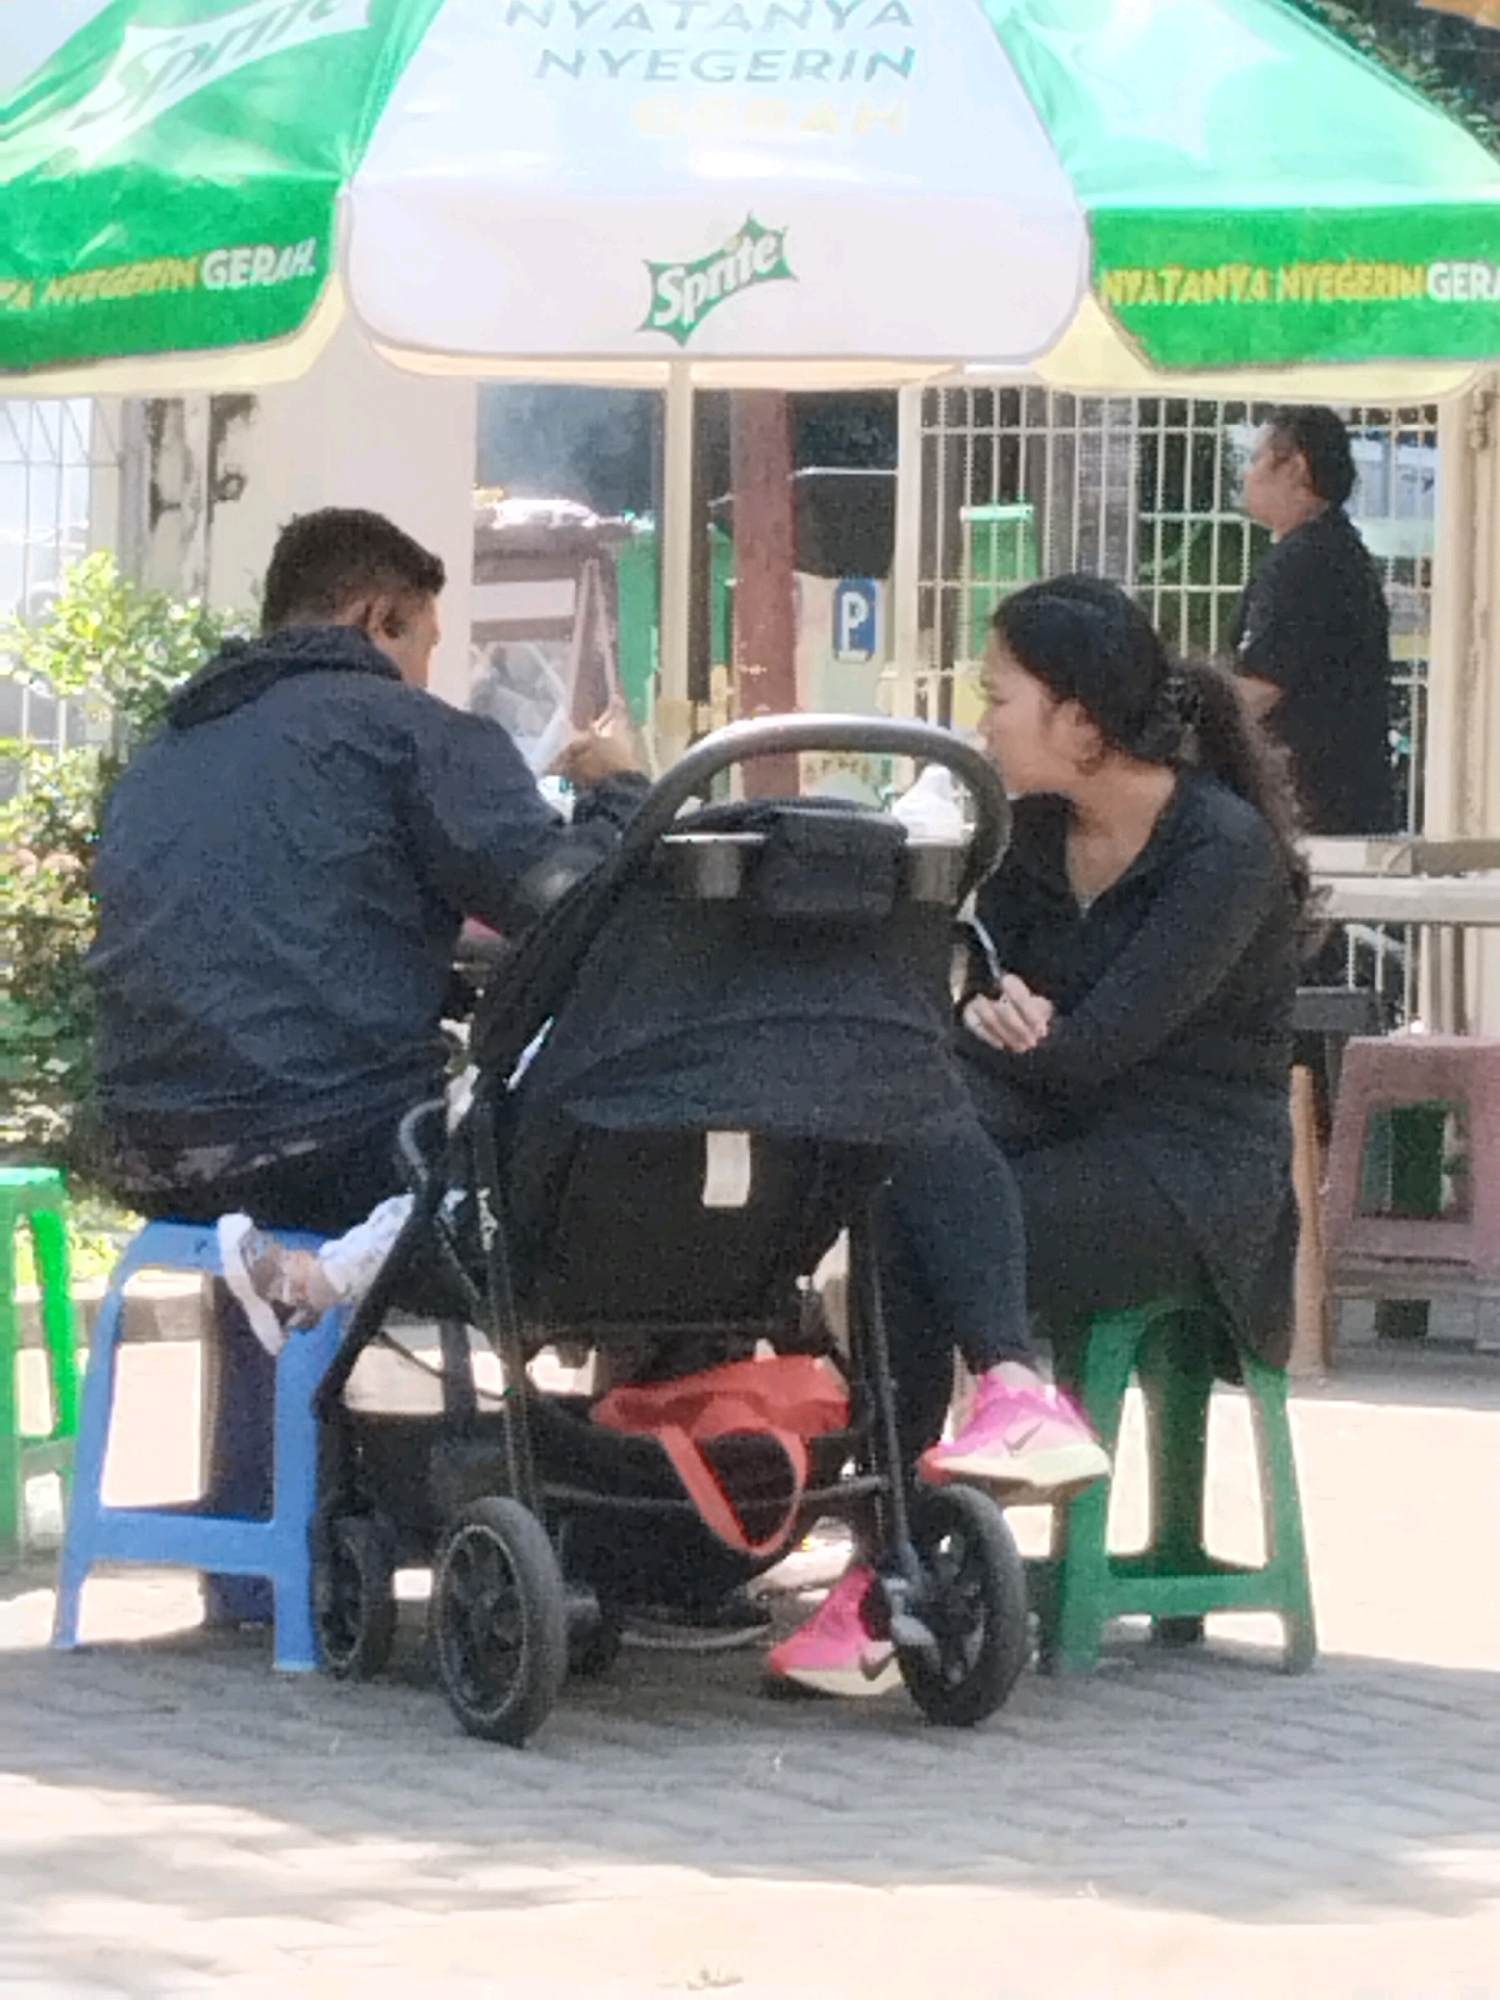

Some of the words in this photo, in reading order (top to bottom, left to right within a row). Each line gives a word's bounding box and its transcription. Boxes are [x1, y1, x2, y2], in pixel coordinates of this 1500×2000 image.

[505, 0, 915, 32] NYATANYA
[533, 47, 916, 82] NYEGERIN
[652, 231, 780, 329] Sprite
[1104, 262, 1271, 305] NYATANYA
[1276, 260, 1426, 302] NYEGERIN
[1426, 260, 1500, 302] GER
[841, 591, 868, 650] P
